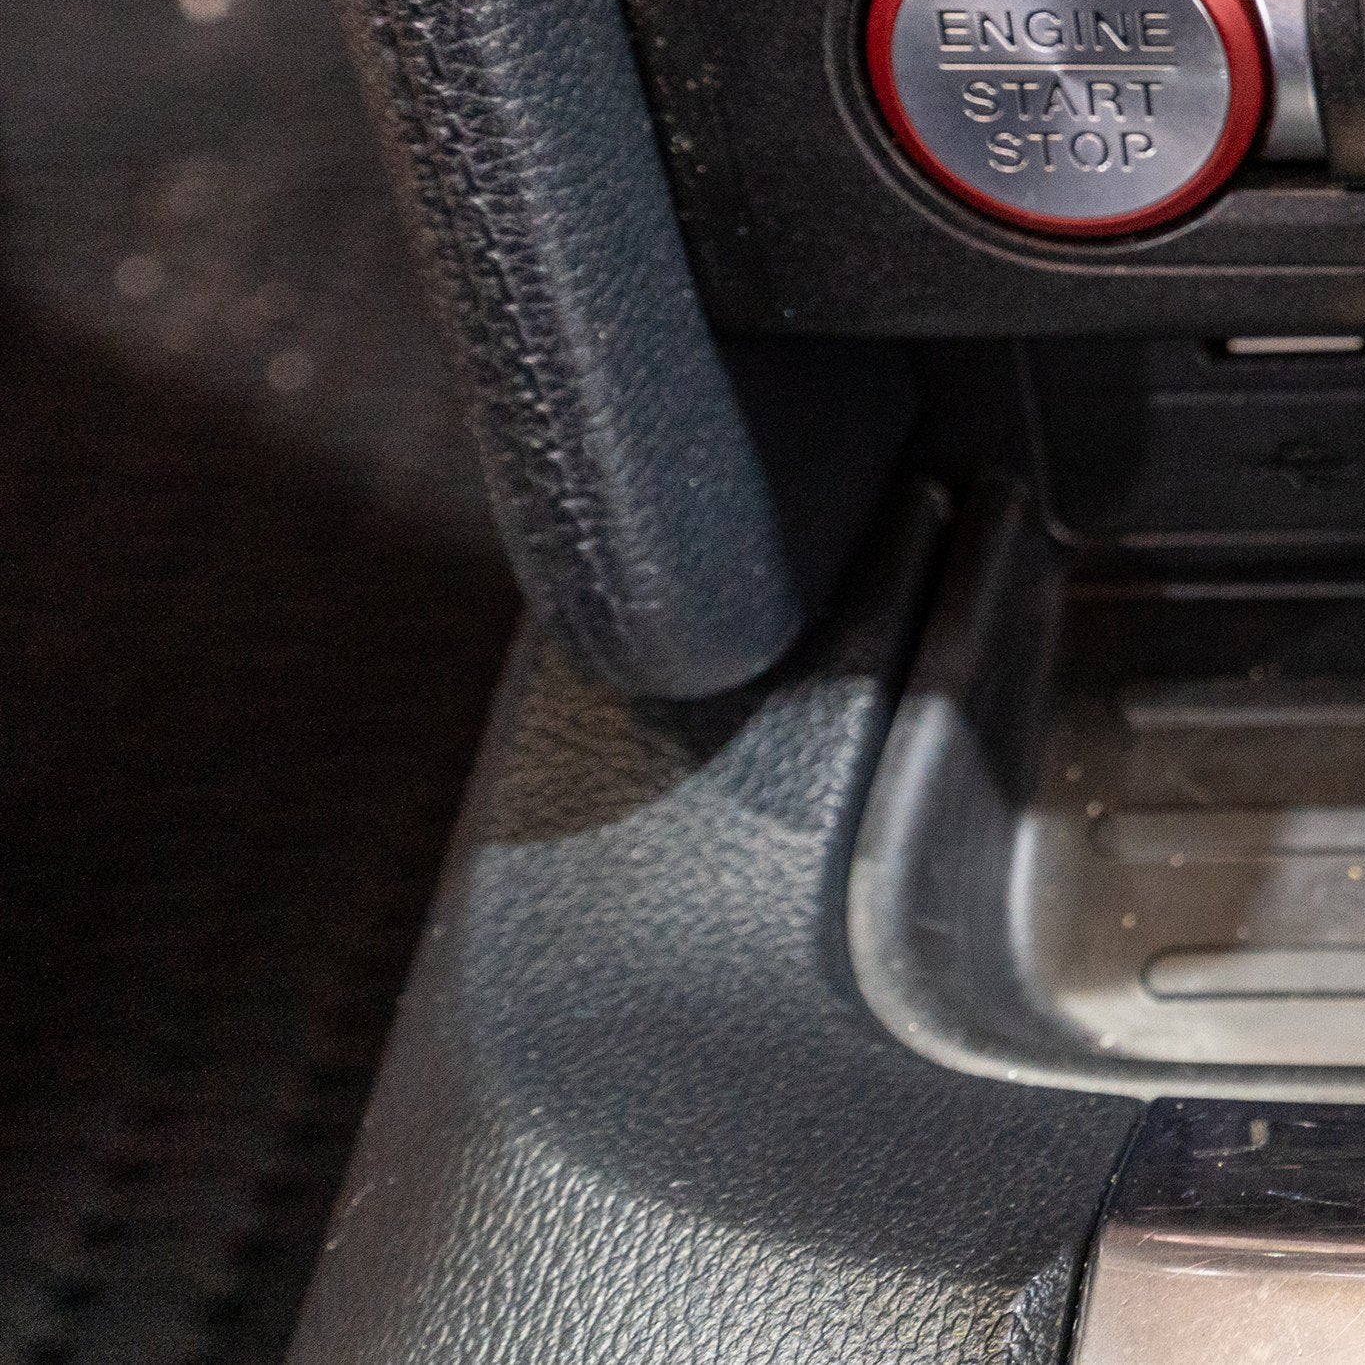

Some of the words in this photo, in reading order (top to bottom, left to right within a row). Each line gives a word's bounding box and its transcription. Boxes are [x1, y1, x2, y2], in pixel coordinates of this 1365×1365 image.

[936, 8, 1176, 53] ENGINE
[962, 80, 1164, 123] START
[987, 131, 1157, 174] STOP
